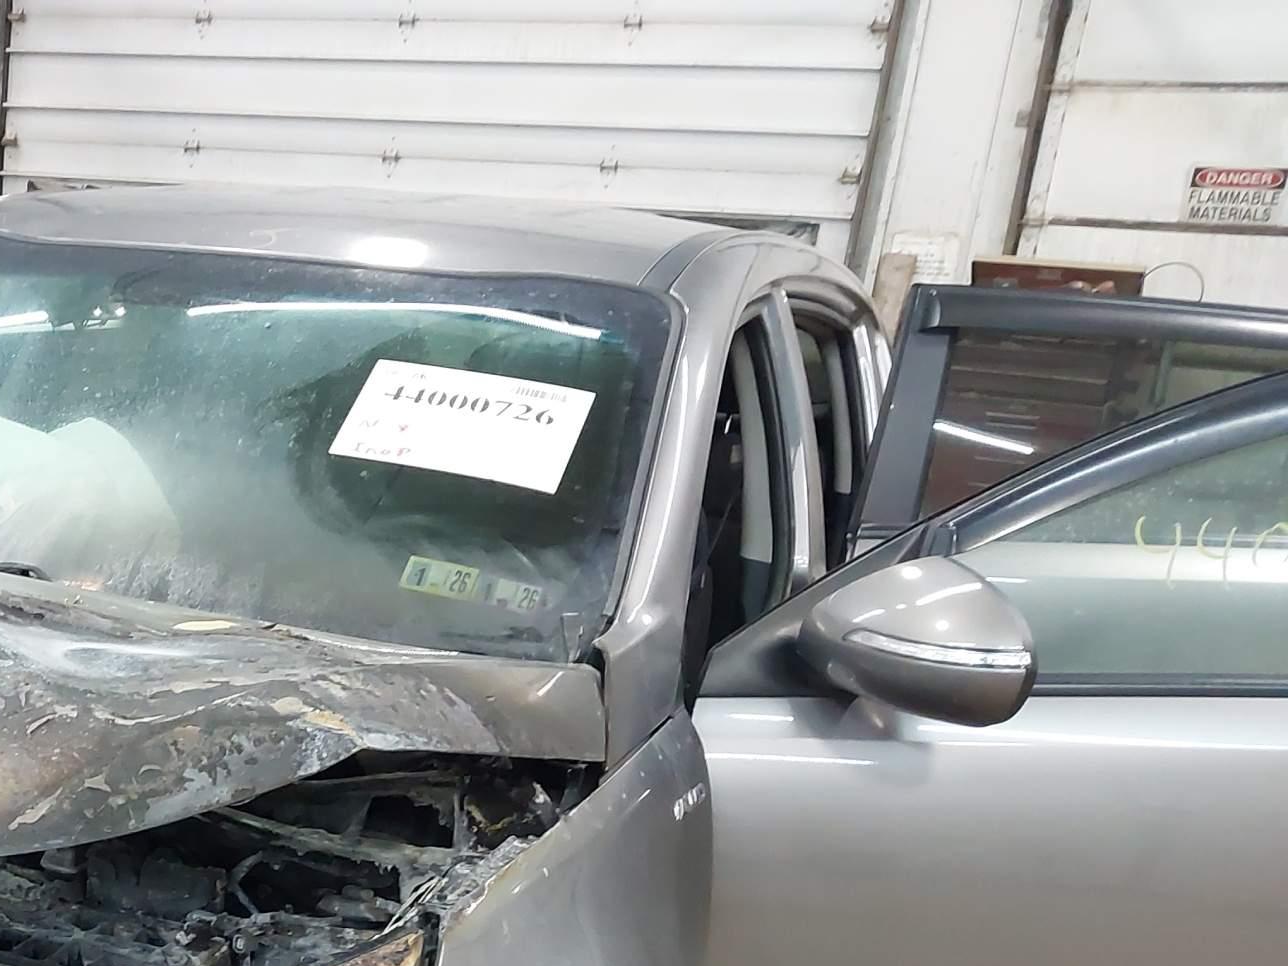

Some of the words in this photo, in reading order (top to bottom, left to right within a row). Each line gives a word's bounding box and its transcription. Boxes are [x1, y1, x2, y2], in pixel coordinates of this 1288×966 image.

[1204, 171, 1273, 186] DANGER
[1188, 190, 1281, 206] FLAMMABLE
[1188, 206, 1273, 222] MATERIALS
[384, 384, 556, 426] 44000726
[449, 570, 473, 593] 26
[517, 587, 540, 611] 26
